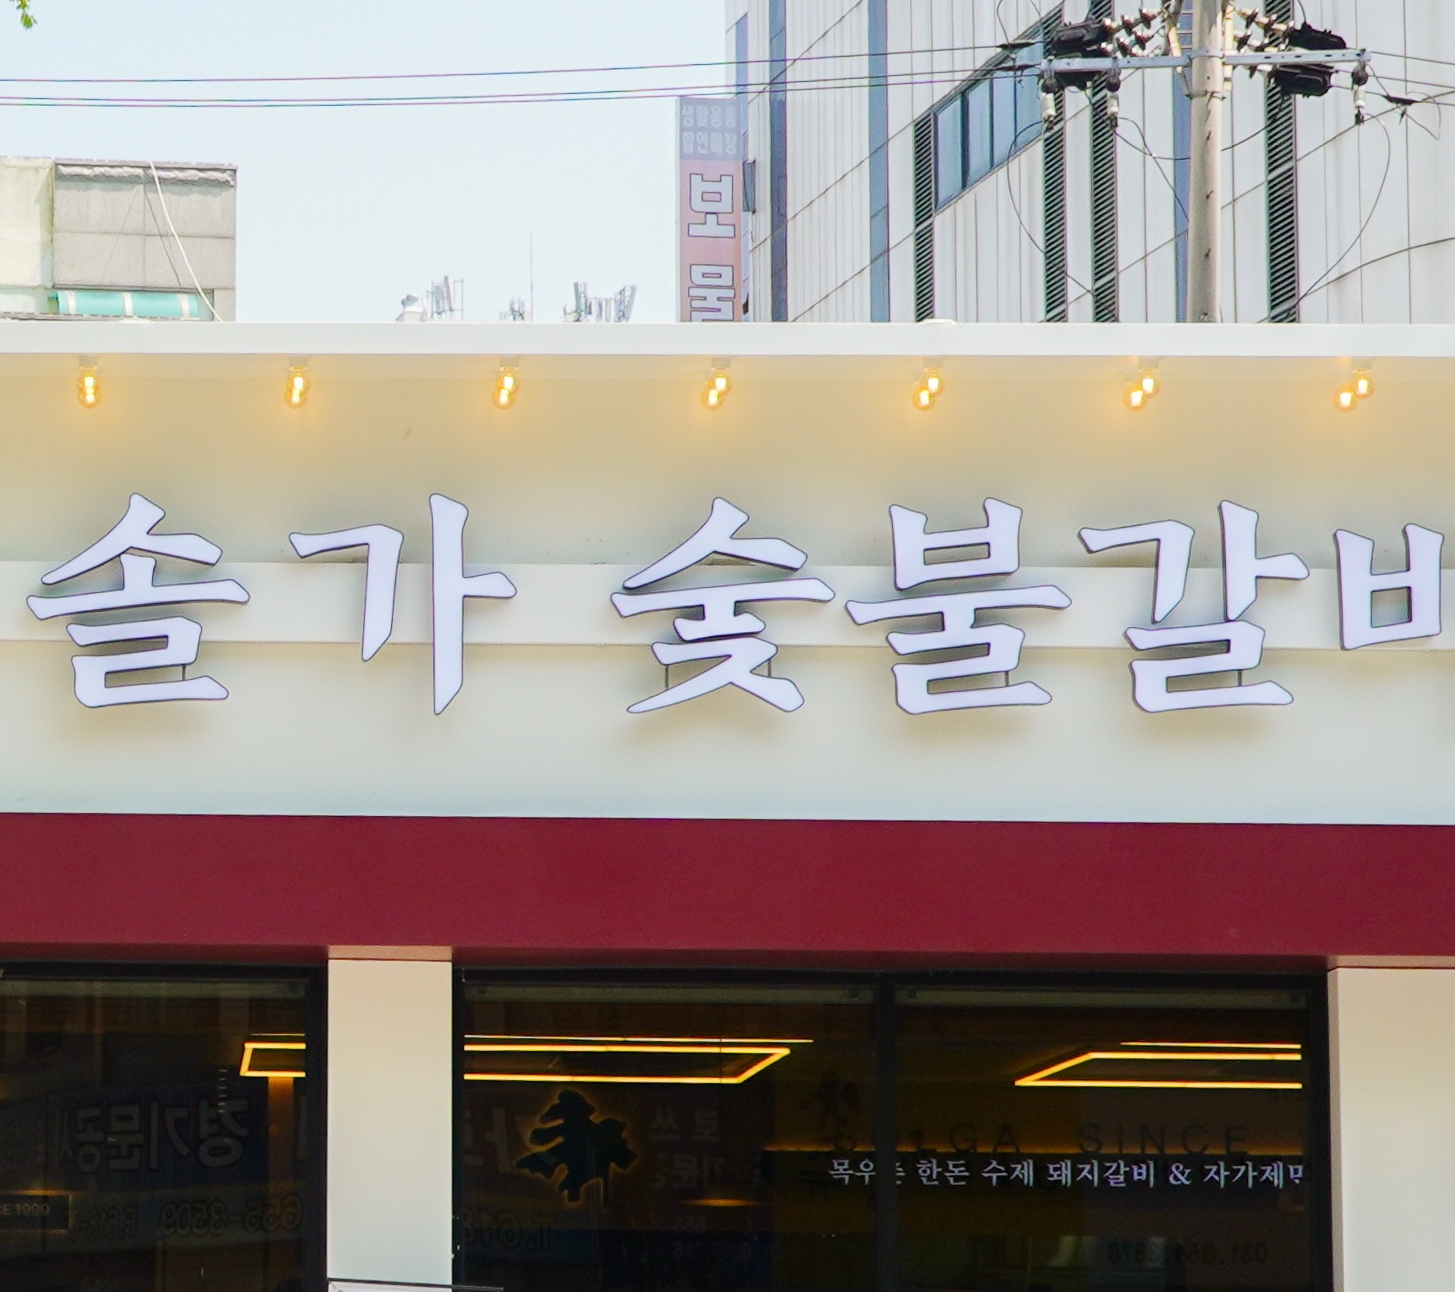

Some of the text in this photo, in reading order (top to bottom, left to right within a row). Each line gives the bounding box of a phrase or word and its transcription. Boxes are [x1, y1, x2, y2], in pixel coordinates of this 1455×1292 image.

[25, 492, 518, 715] 솔가
[915, 1158, 971, 1186] 한돈
[981, 1159, 1034, 1188] 수제
[1046, 1160, 1155, 1188] 돼지갈비
[1168, 1162, 1192, 1186] &
